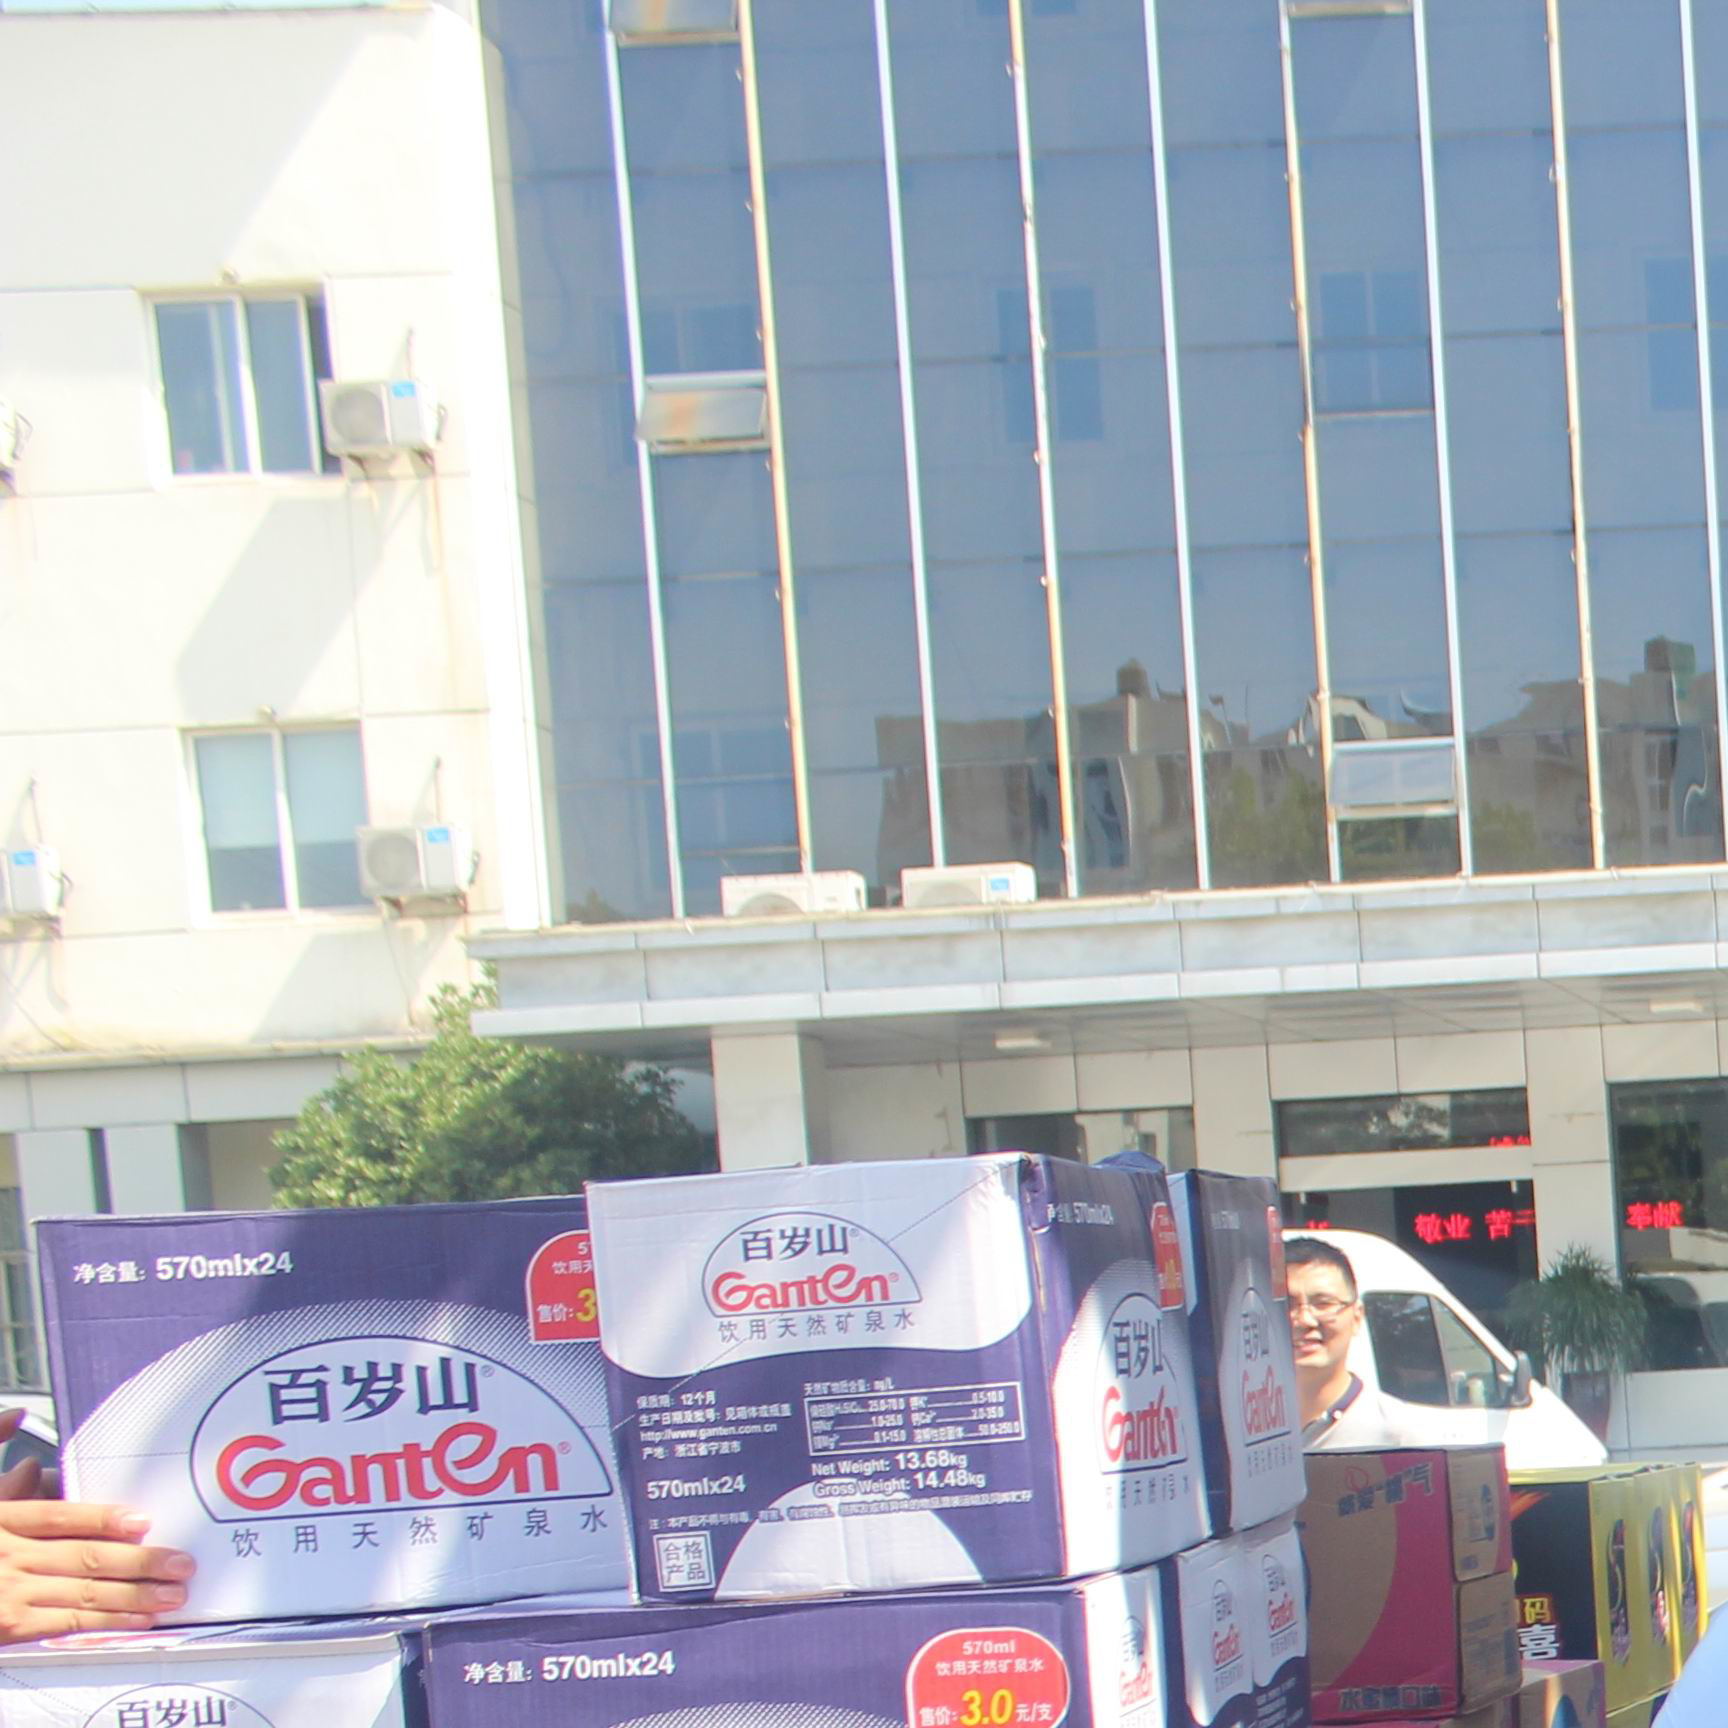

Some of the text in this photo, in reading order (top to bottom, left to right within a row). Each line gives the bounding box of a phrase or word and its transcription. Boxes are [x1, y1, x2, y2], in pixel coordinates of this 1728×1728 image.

[740, 1222, 850, 1263] 百岁山
[156, 1251, 294, 1281] 570mlx24
[710, 1263, 891, 1313] Ganten
[717, 1307, 917, 1344] 饮用天然矿泉水
[264, 1356, 480, 1425] 百岁山
[216, 1421, 560, 1512] Ganten
[811, 1450, 968, 1476] Net Weight: 13.68kg
[647, 1475, 746, 1500] 570mlx24
[814, 1469, 986, 1497] Gross Weight: 14.48kg
[231, 1504, 608, 1559] 饮用天然矿泉水
[541, 1650, 676, 1680] 570mlx24
